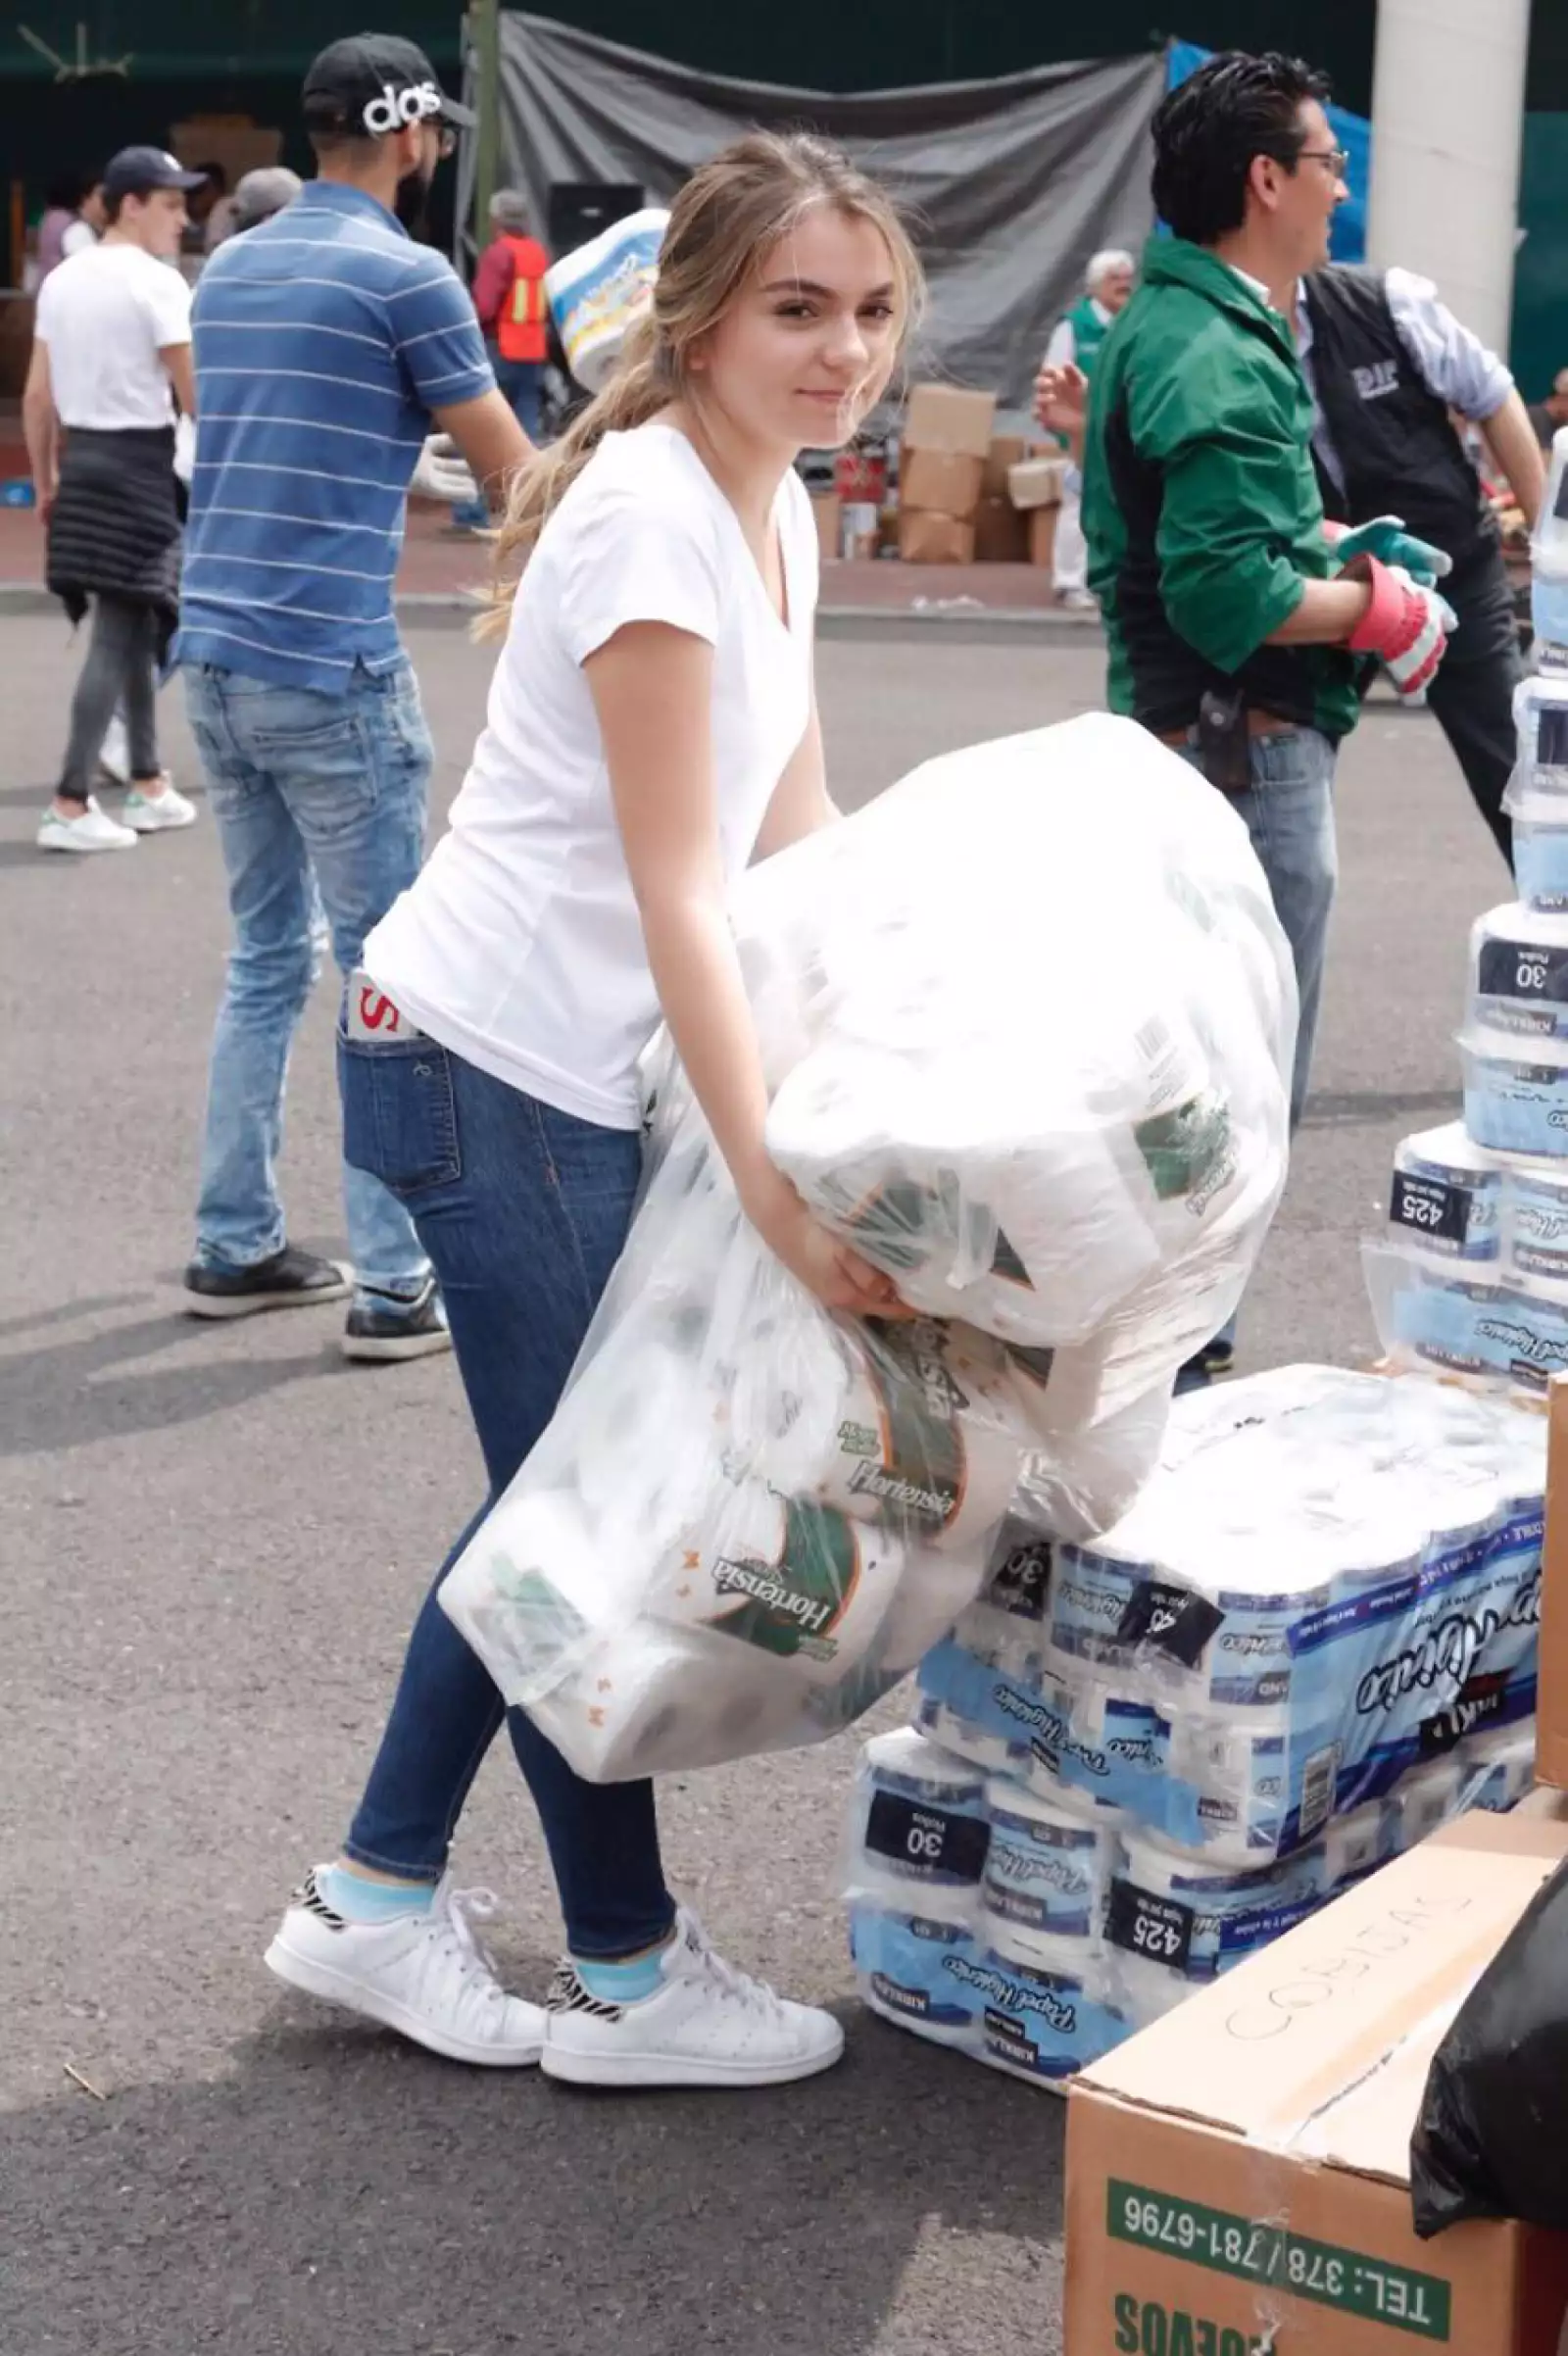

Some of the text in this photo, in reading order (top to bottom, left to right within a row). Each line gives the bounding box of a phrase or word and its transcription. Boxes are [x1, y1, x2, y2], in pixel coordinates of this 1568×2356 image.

[1516, 963, 1546, 989] 30
[1401, 1194, 1445, 1227] 425
[847, 1458, 956, 1516] Hortensia
[1005, 1550, 1044, 1585] 30
[711, 1558, 832, 1632] Hortensia
[906, 1828, 945, 1859] 30
[1132, 1915, 1181, 1958] 425
[1016, 1987, 1077, 2035] Papel
[1123, 2195, 1259, 2270] 781-6796
[1288, 2245, 1345, 2298] 378
[1354, 2267, 1432, 2324] TEL:
